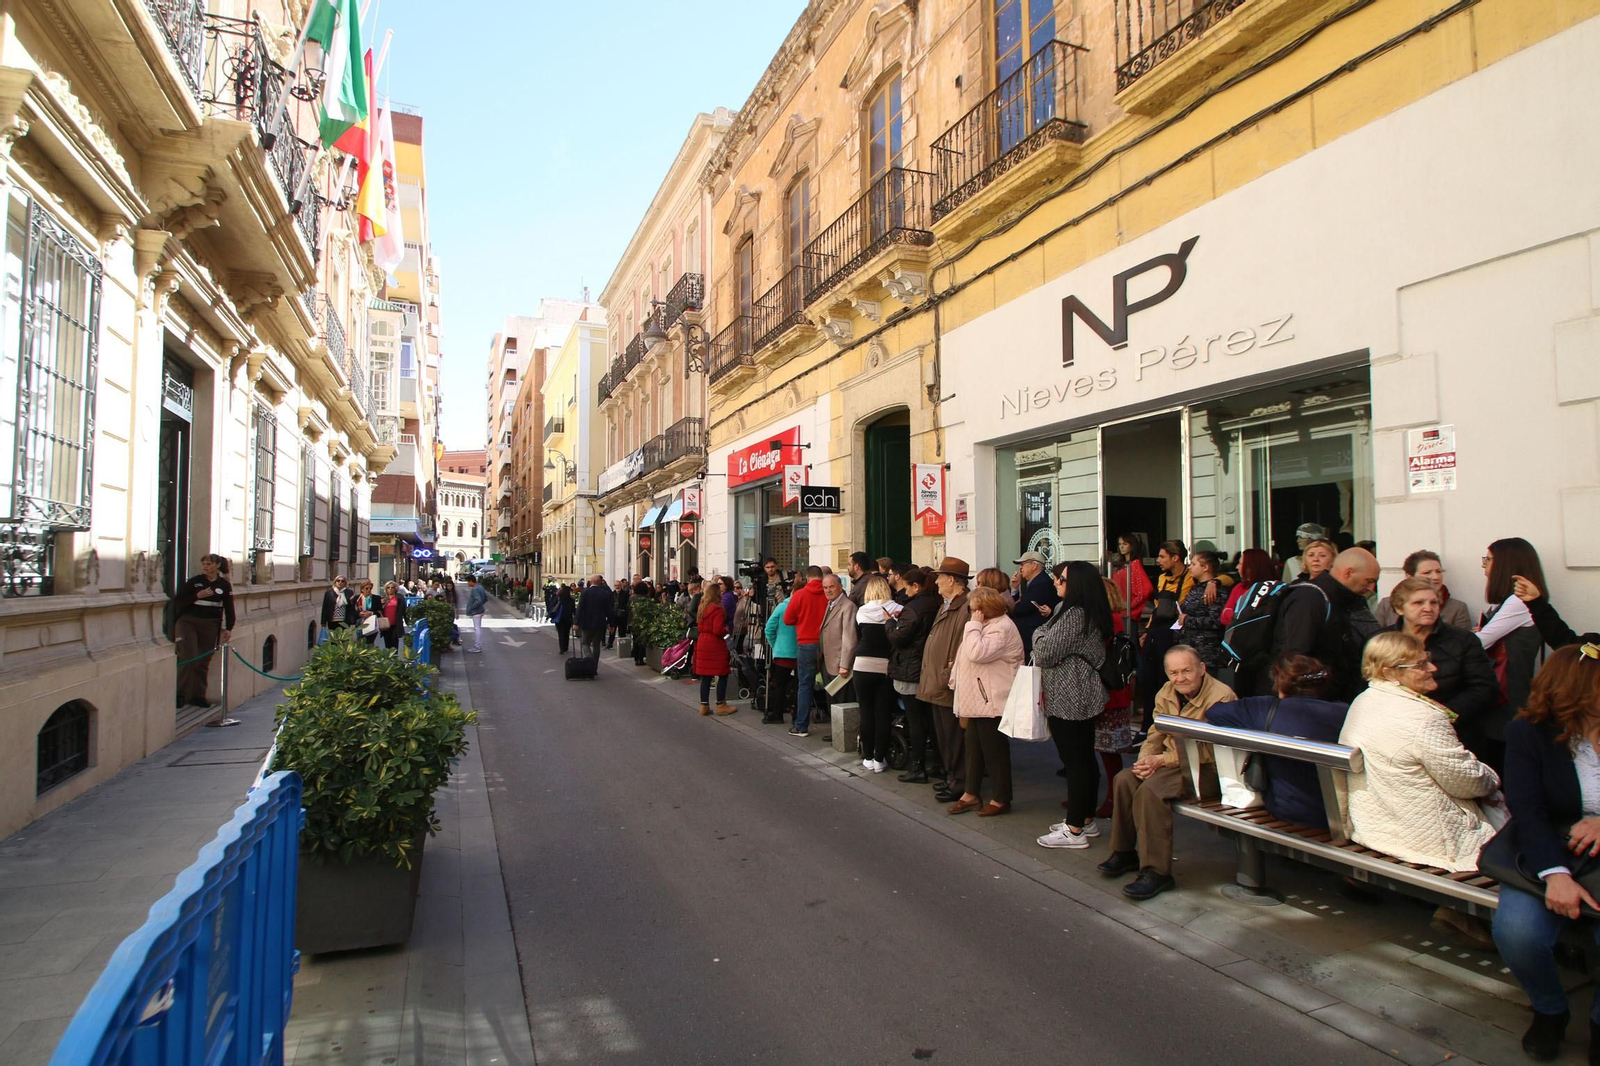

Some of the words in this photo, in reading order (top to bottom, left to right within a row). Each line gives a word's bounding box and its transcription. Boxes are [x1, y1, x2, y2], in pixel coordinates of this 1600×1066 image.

[1000, 367, 1118, 420] Nieves
[1134, 313, 1296, 382] Pérez
[739, 457, 748, 476] La
[1411, 455, 1454, 466] Alarma
